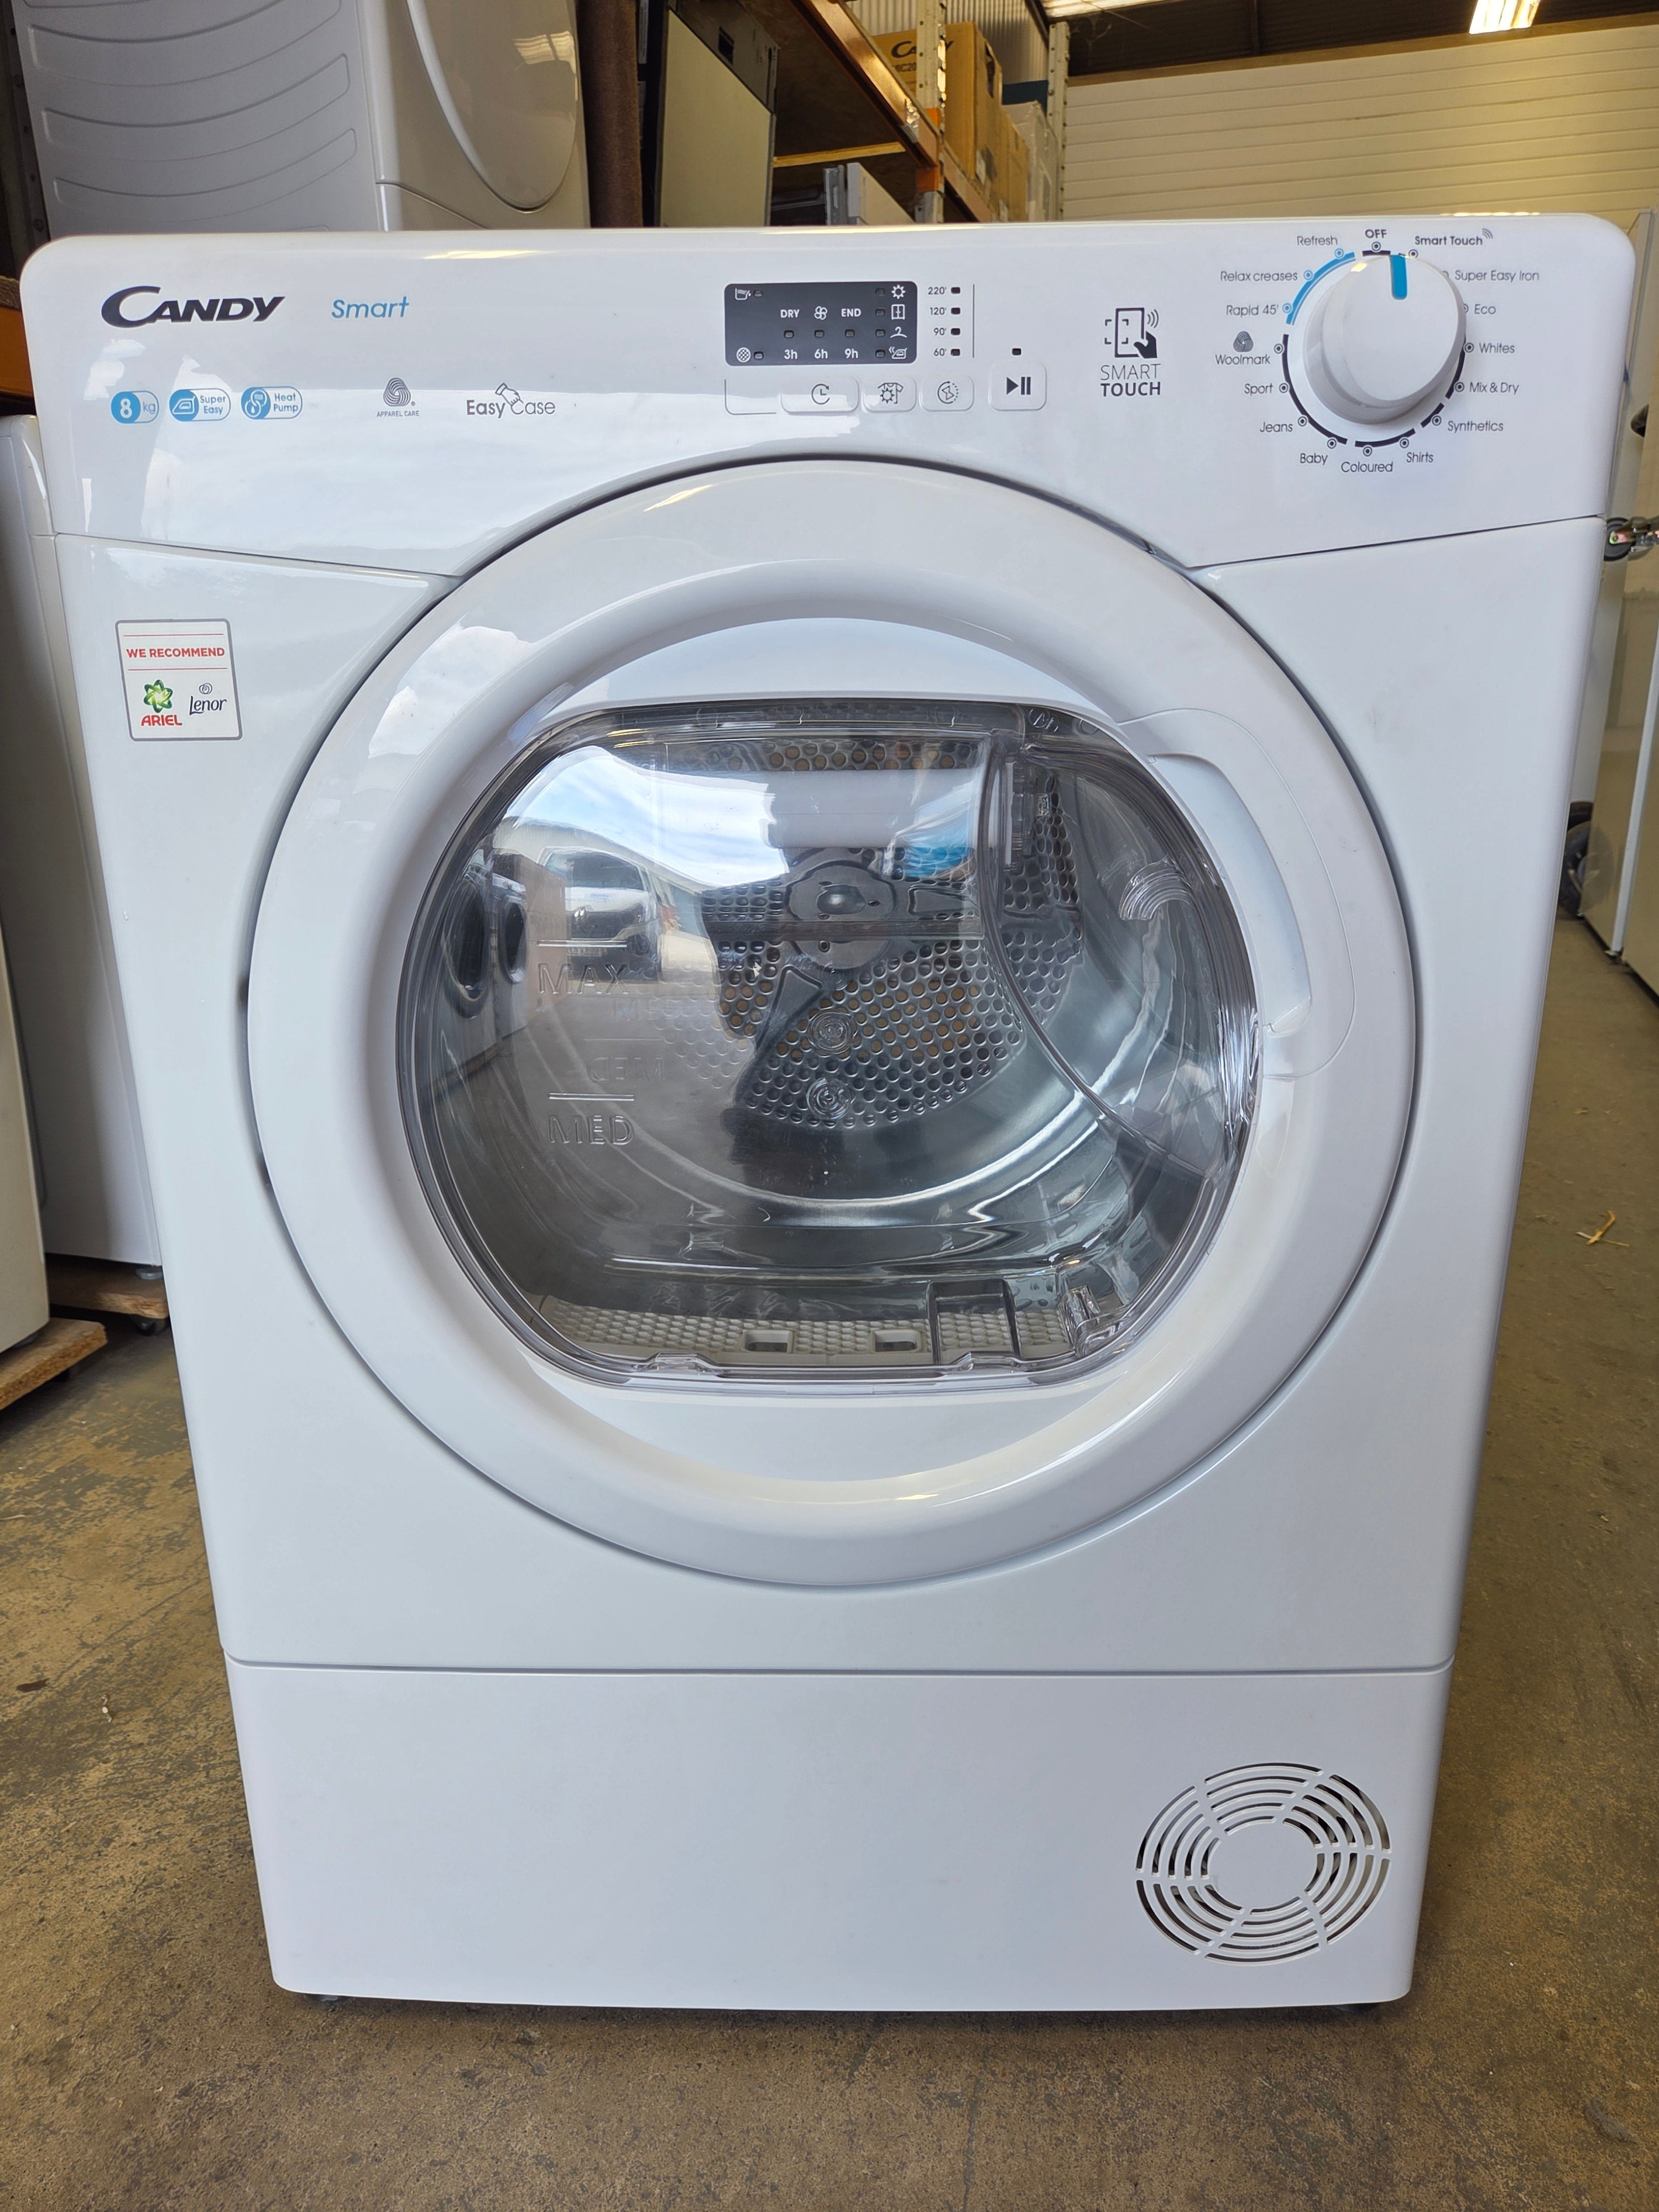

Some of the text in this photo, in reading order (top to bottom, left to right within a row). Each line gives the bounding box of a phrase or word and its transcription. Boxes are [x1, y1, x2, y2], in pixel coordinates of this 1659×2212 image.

[1364, 229, 1387, 239] OFF
[1296, 235, 1338, 247] Refresh
[1414, 235, 1483, 246] Smart Touch
[1220, 270, 1298, 282] Relax creases
[1454, 270, 1540, 283] Super Easy Iron
[101, 285, 285, 328] CANDY
[331, 296, 410, 319] Smart
[841, 307, 862, 317] END
[1225, 305, 1259, 317] Rapid
[1473, 304, 1496, 315] Eco
[780, 308, 800, 319] DRY
[784, 349, 798, 359] 3h
[814, 348, 828, 359] 6h
[844, 348, 858, 359] 9h
[1478, 342, 1515, 354] Whites
[1214, 354, 1271, 366] Woolmark
[1100, 363, 1161, 380] SMART
[1100, 382, 1161, 397] TOUCH
[1244, 383, 1274, 395] Sport
[1469, 382, 1520, 395] Mix & Dry
[200, 395, 226, 404] Super
[274, 393, 296, 401] Heat
[120, 398, 155, 419] 8 kg
[204, 405, 223, 416] Easy
[273, 404, 299, 413] Pump
[466, 399, 555, 418] Easy Case
[1259, 421, 1293, 433] Jeans
[1447, 420, 1504, 433] Synthetics
[1300, 452, 1328, 466] Baby
[1406, 451, 1434, 463] Shirts
[1340, 461, 1394, 473] Coloured
[126, 647, 225, 658] WE RECOMMEND
[189, 696, 227, 716] Lenor
[141, 714, 182, 726] ARIEL
[537, 963, 630, 995] MAX
[547, 1114, 634, 1145] MED
